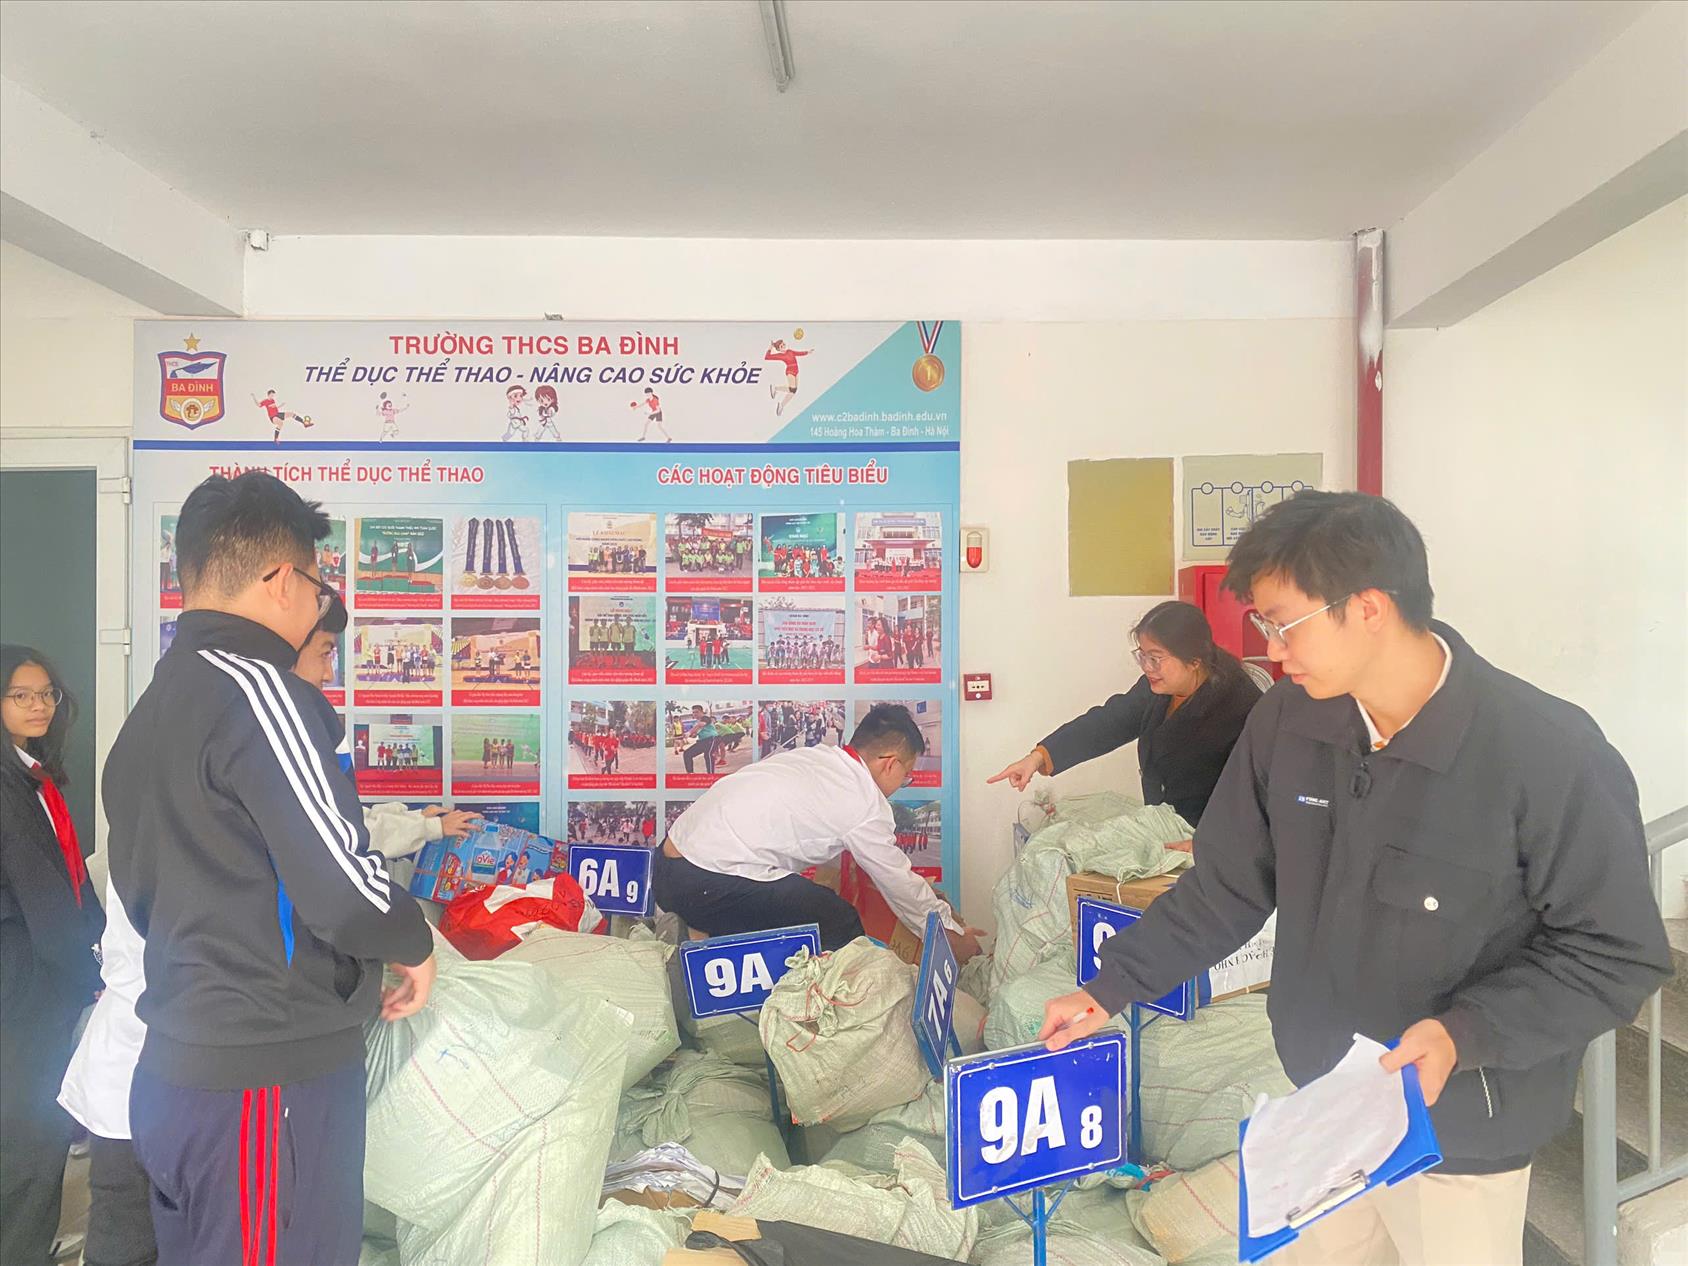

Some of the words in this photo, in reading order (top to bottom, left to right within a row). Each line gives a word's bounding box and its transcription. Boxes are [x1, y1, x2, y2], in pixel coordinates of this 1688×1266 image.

[389, 331, 493, 355] TRƯỜNG
[502, 335, 569, 355] THCS
[578, 336, 612, 355] BA
[619, 331, 679, 355] ĐÌNH
[305, 357, 350, 383] THỂ
[352, 366, 397, 386] DỤC
[406, 357, 450, 383] THỂ
[455, 366, 512, 383] THAO
[531, 361, 593, 384] NÂNG
[599, 366, 643, 384] CAO
[649, 363, 694, 384] SỨC
[701, 361, 761, 384] KHỎE
[172, 383, 185, 392] BA
[188, 381, 213, 392] ĐÌNH
[812, 411, 947, 422] www.c2badinh.badinh.edu.vn
[810, 427, 823, 436] 145
[890, 427, 901, 436] Ba
[273, 462, 312, 481] TÍCH
[318, 459, 351, 481] THỂ
[357, 467, 391, 484] DỤC
[397, 459, 431, 482] THỂ
[437, 467, 483, 482] THAO
[658, 462, 693, 484] CÁC
[699, 468, 744, 488] HOẠT
[750, 464, 799, 487] ĐỘNG
[807, 463, 843, 484] TIÊU
[848, 459, 888, 484] BIỂU
[578, 857, 619, 898] 6A
[626, 880, 638, 904] 9
[703, 951, 774, 998] 9A
[928, 970, 948, 1041] 7A
[944, 960, 952, 984] 6
[979, 1075, 1066, 1165] 9A
[1080, 1105, 1103, 1149] 8
